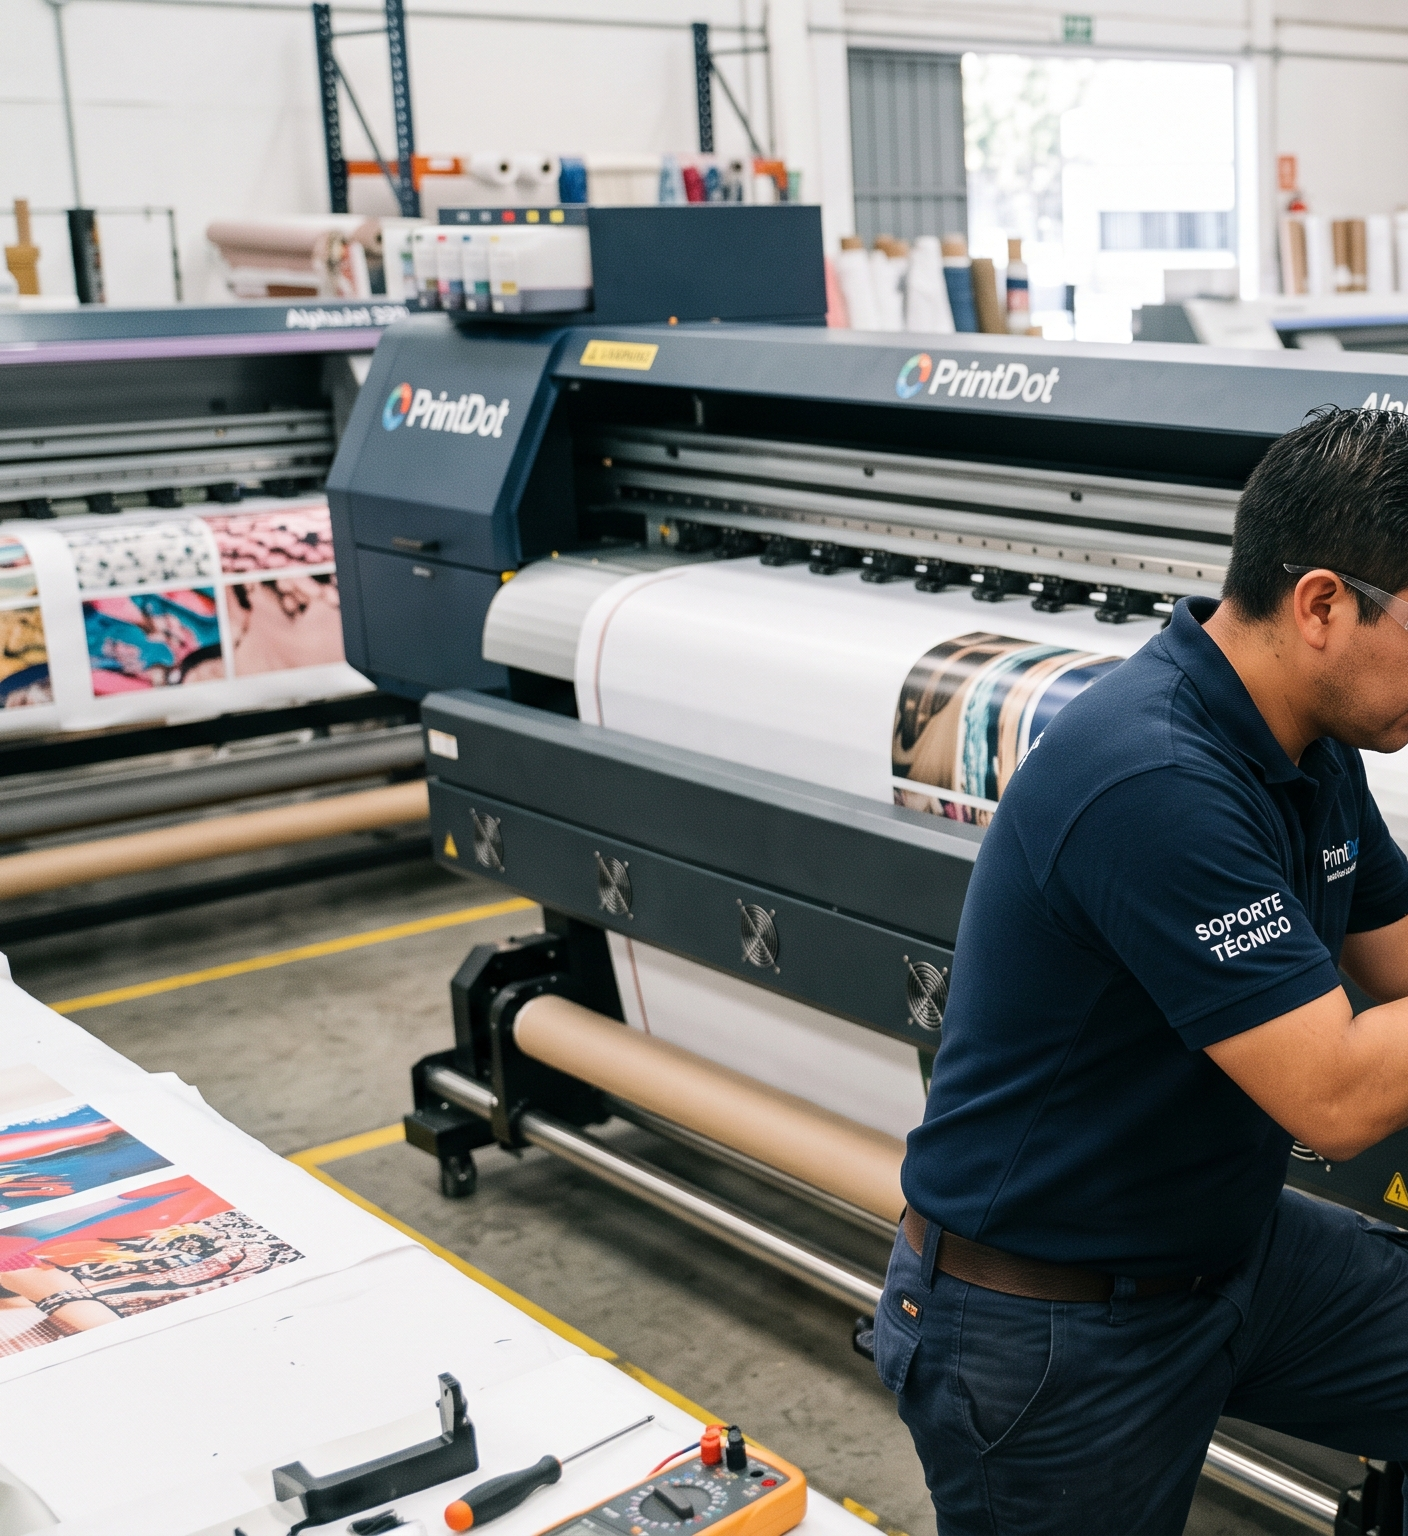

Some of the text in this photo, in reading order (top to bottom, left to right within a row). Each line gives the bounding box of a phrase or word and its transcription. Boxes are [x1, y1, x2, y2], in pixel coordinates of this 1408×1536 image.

[928, 359, 1060, 404] PrintDot
[406, 388, 510, 438] PrintDot
[1195, 893, 1284, 941] SOPORTE
[1210, 916, 1291, 962] TÉCNICO
